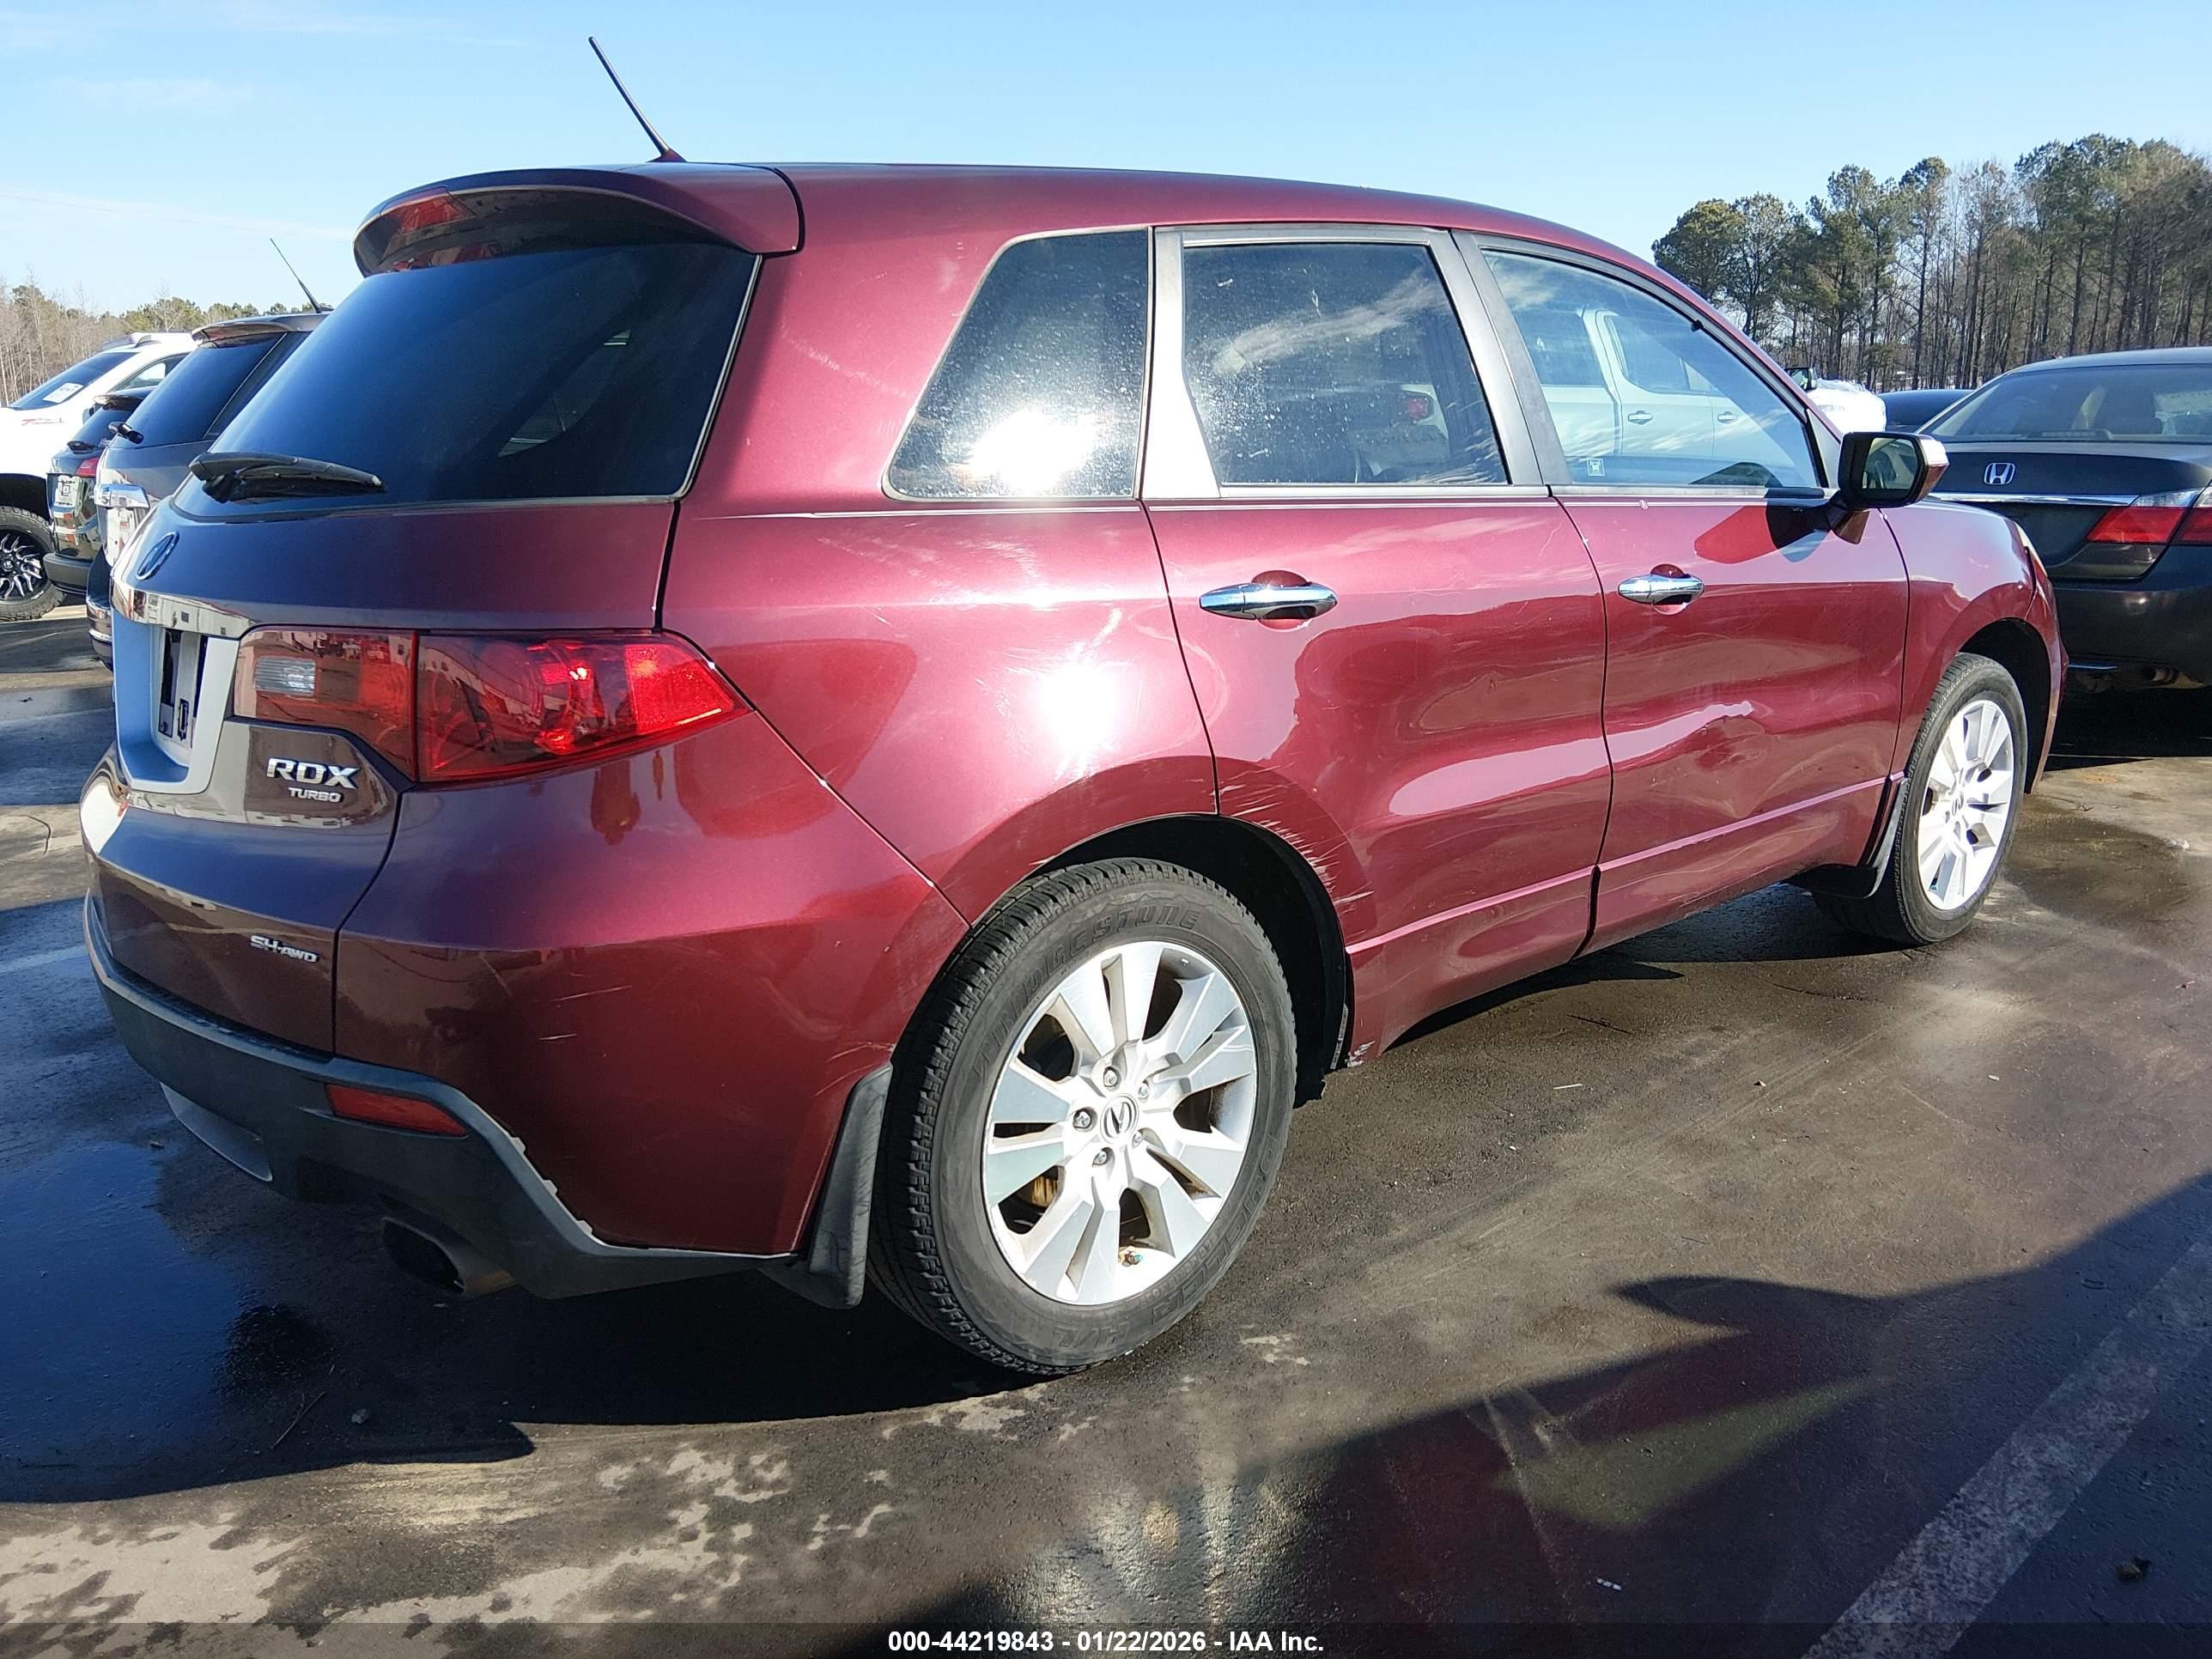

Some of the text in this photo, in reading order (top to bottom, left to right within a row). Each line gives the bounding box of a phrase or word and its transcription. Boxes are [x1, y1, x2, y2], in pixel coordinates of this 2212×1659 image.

[266, 757, 361, 789] RDX
[288, 787, 343, 803] TURBO
[250, 935, 319, 963] SH-AWD
